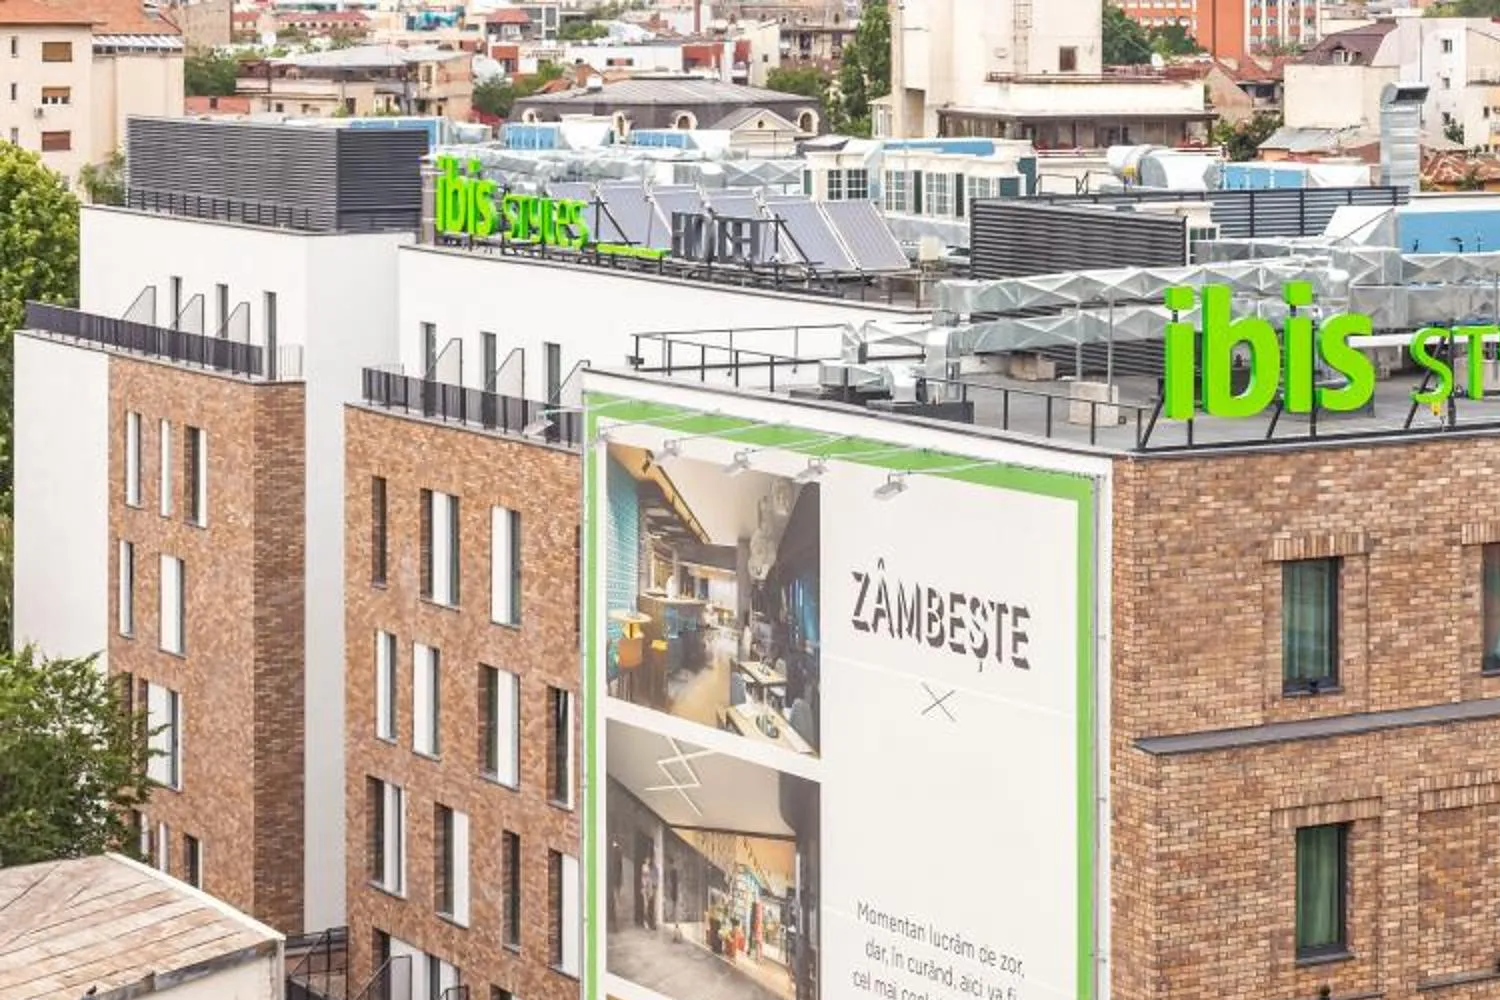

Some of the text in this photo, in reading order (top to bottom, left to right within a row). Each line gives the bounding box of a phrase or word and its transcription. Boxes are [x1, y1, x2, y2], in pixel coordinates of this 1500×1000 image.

[435, 153, 498, 236] ibis
[1164, 281, 1376, 420] ibis
[857, 900, 926, 942] Momentan
[930, 923, 975, 959] lucrăm
[979, 944, 997, 967] de
[853, 970, 872, 992] cel
[875, 978, 897, 1000] mai
[866, 938, 888, 967] dar,
[960, 975, 983, 998] aici
